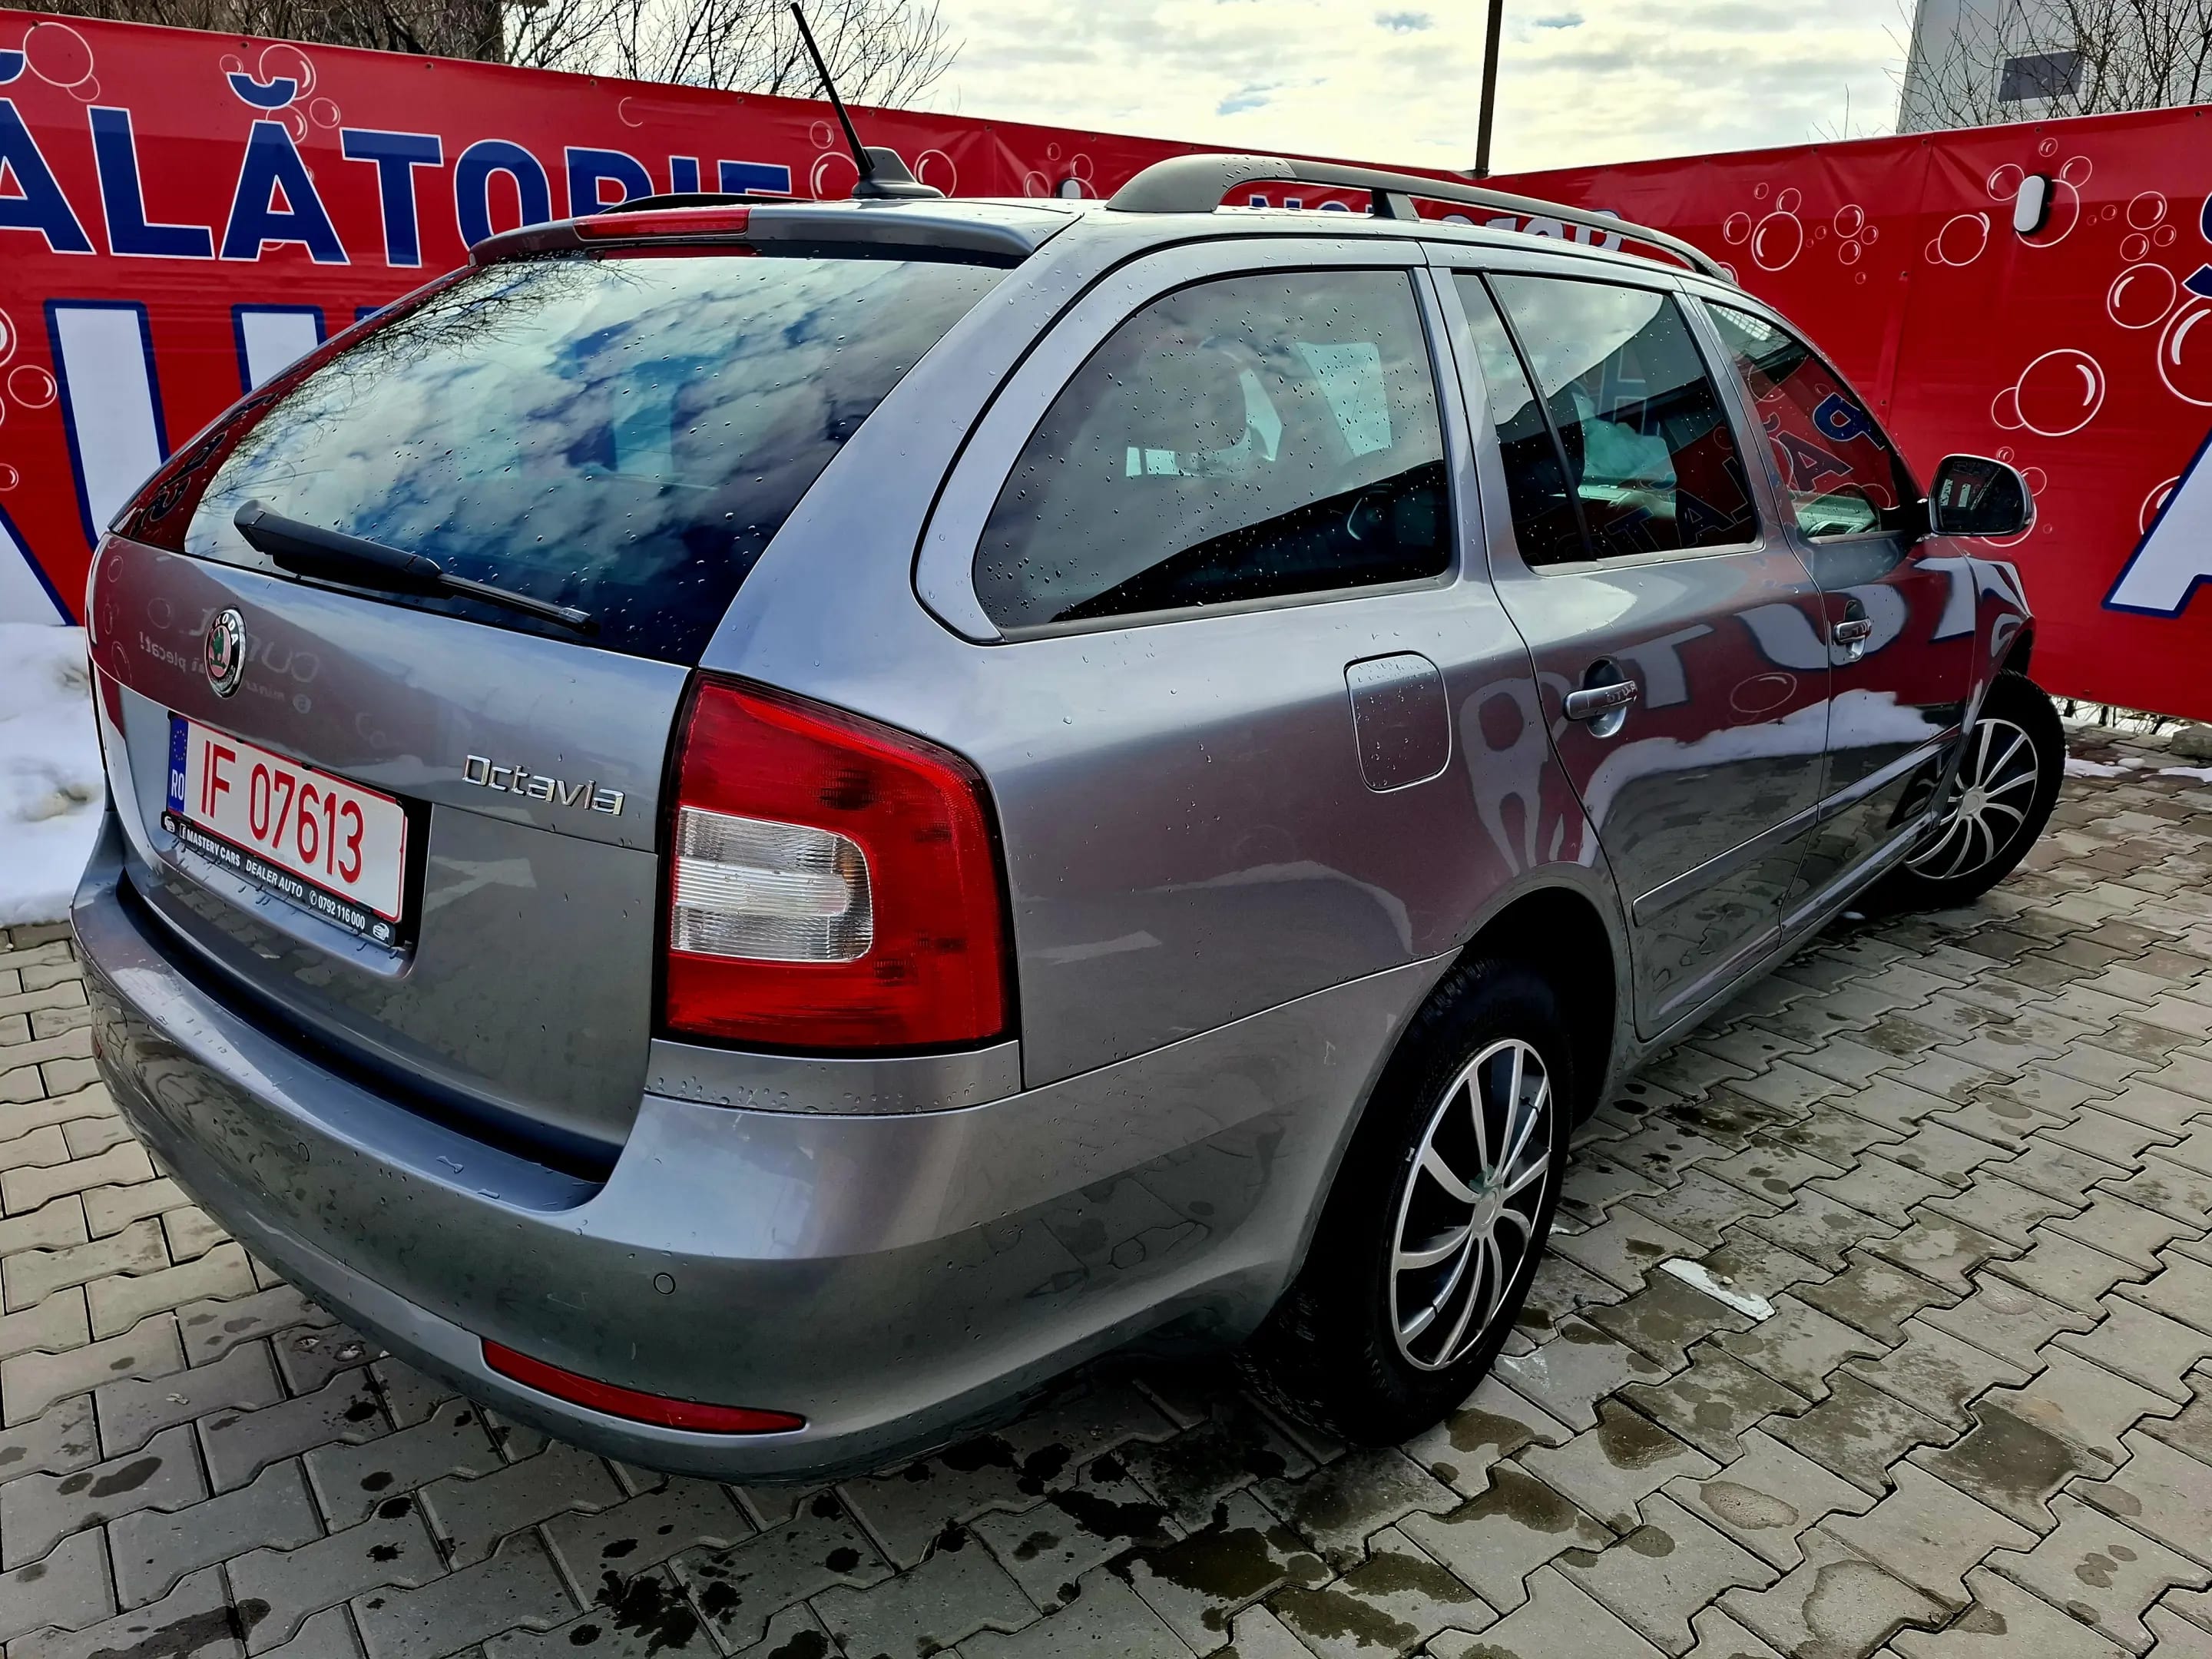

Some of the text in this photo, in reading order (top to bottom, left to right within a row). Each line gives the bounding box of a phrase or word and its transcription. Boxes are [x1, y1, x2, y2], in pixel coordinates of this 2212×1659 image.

[171, 769, 184, 801] RO
[200, 740, 364, 883] IF 07613
[462, 754, 625, 816] Octavia
[187, 830, 220, 856] MASTERY
[220, 848, 240, 867] CARS
[246, 859, 278, 884] DEALER
[278, 876, 303, 898] AUTO
[318, 895, 336, 915] 0792
[336, 904, 350, 922] 116
[351, 912, 366, 930] 000
